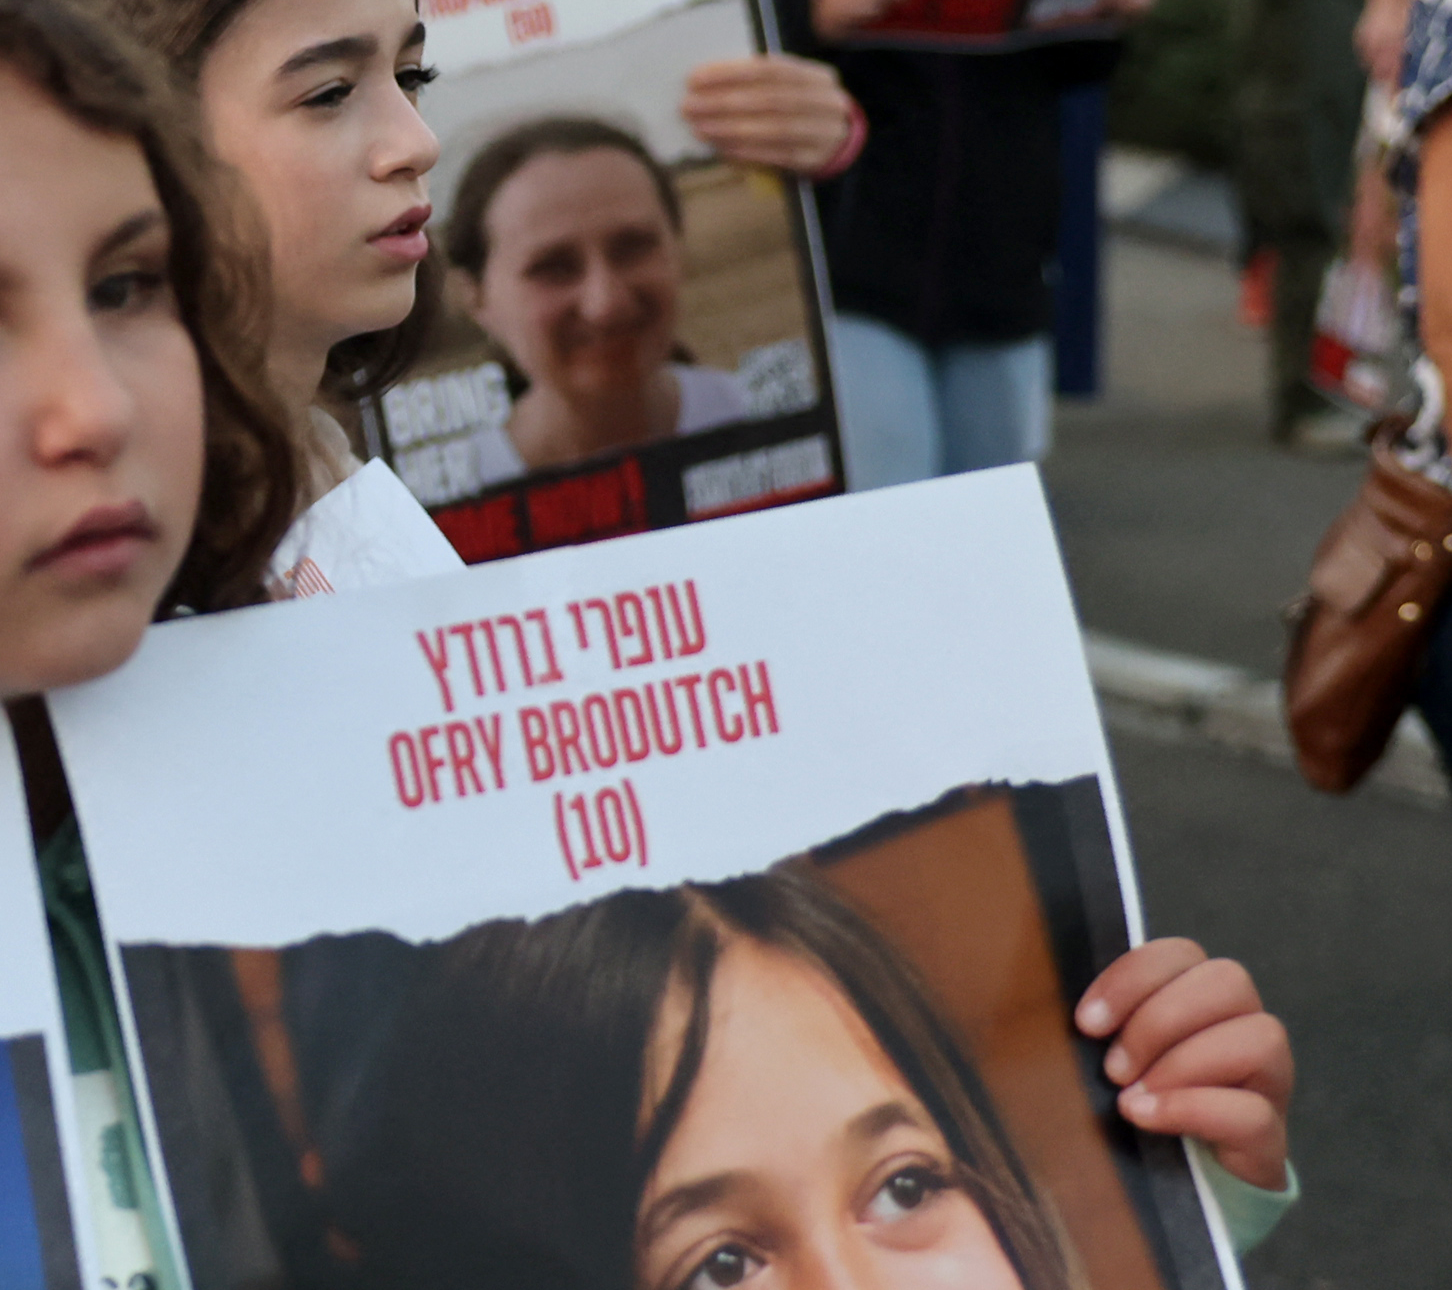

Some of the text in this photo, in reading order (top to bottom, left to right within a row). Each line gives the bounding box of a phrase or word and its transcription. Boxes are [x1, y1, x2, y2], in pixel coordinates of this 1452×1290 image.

[415, 578, 707, 712] עופרי ברודץ
[388, 659, 781, 809] OFRY BRODUTCH
[553, 778, 649, 882] (10)
